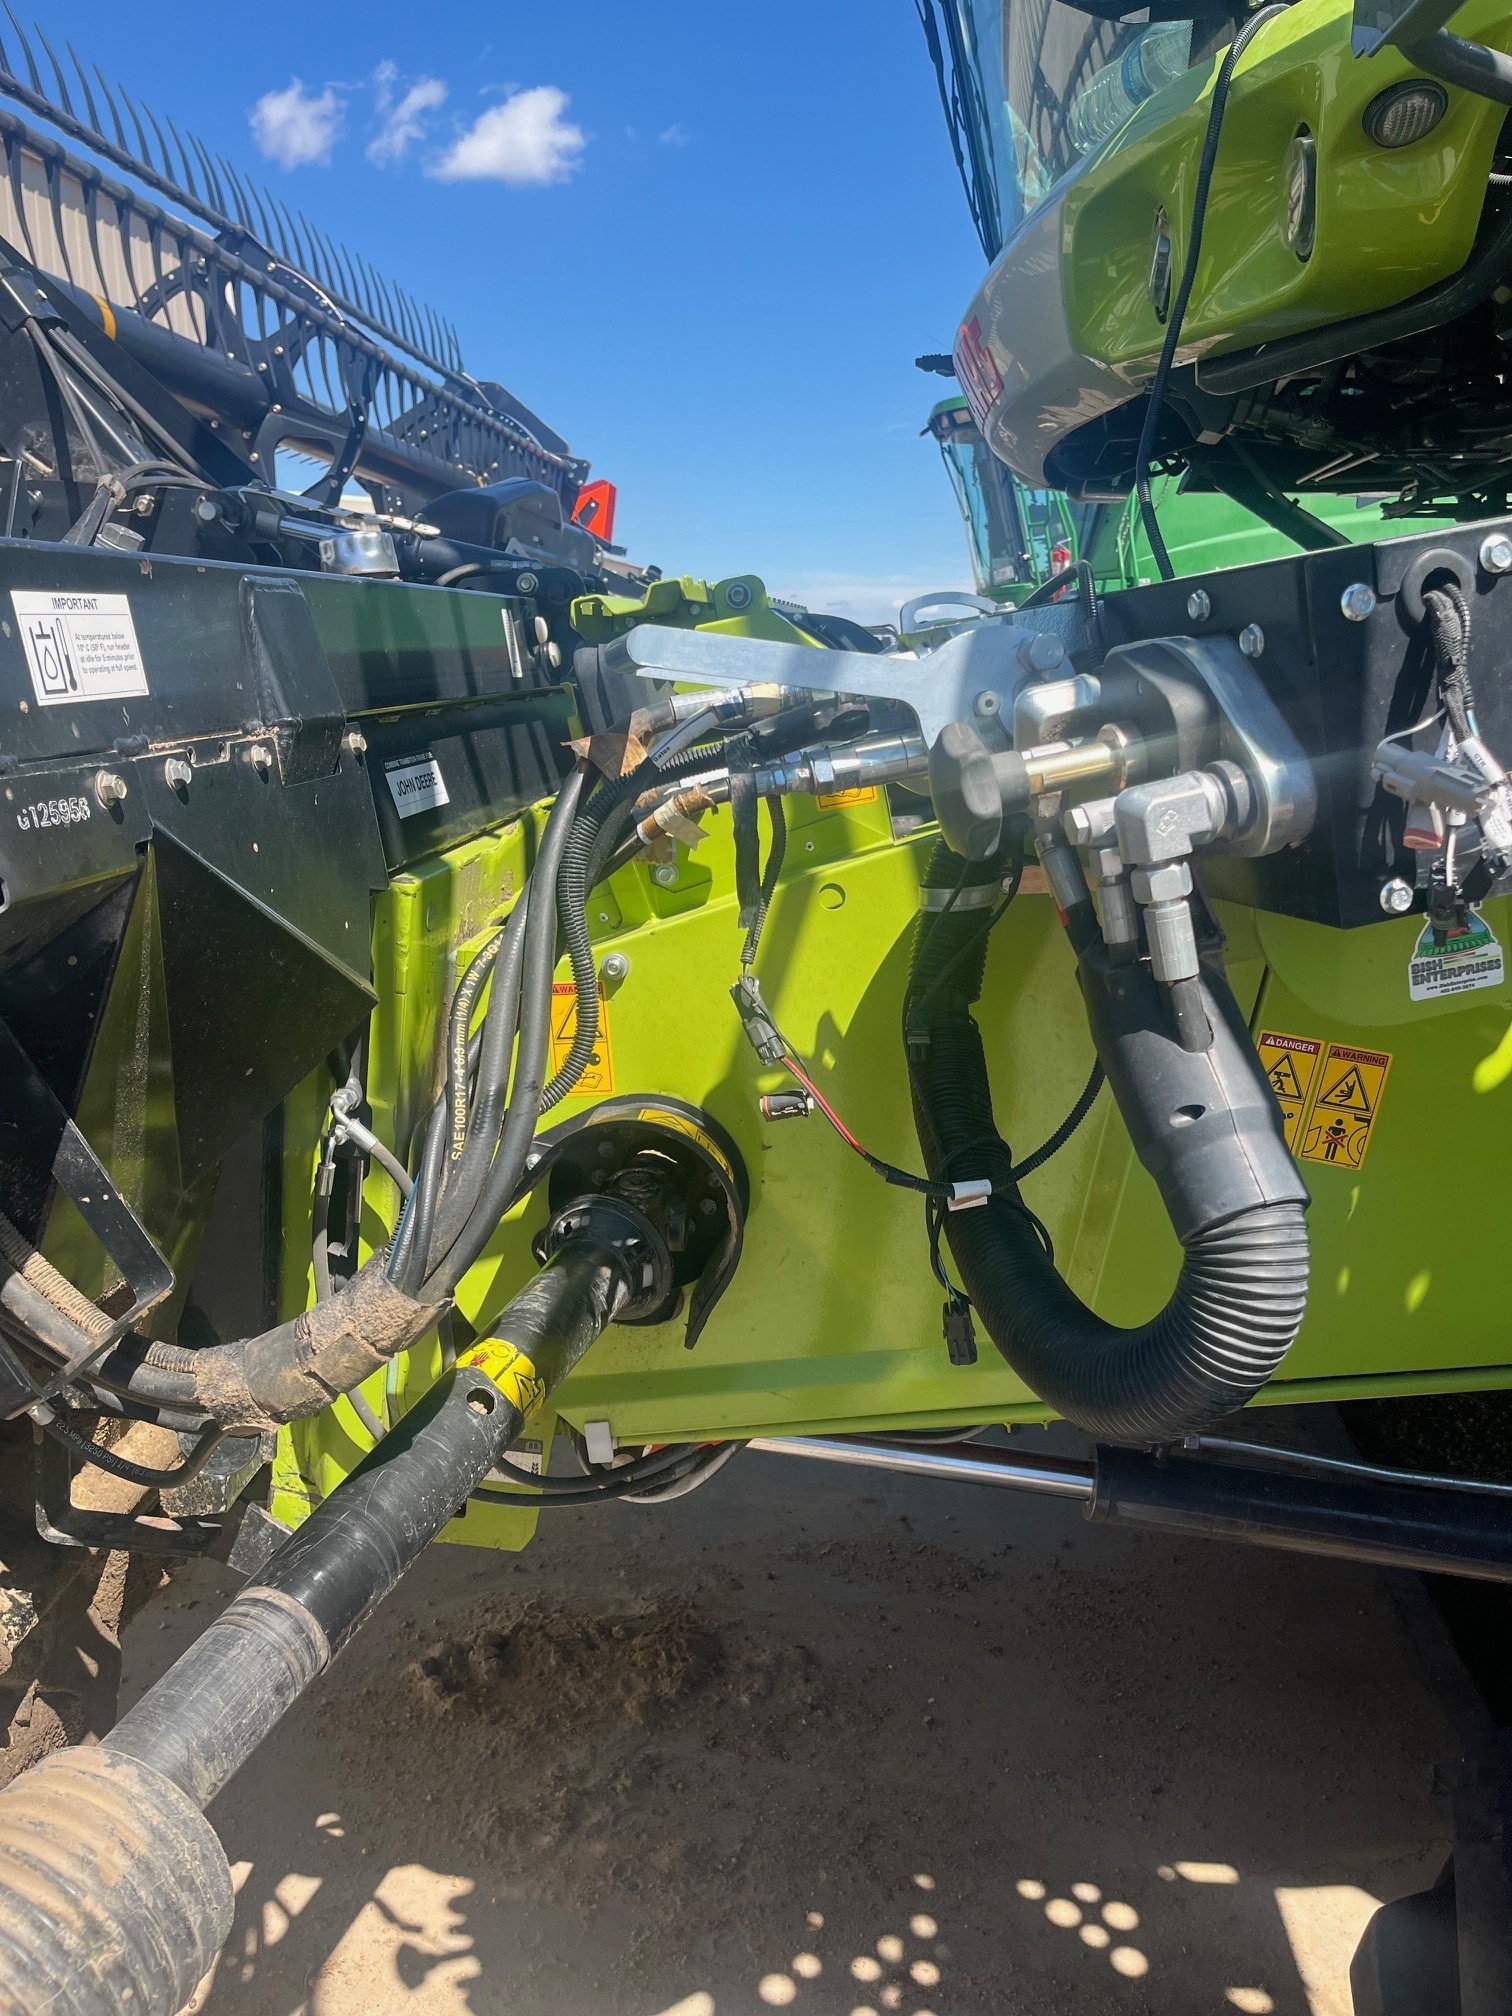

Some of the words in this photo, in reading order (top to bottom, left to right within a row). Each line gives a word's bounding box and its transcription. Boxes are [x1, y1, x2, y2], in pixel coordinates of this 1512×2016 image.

[51, 597, 98, 610] IMPORTANT
[81, 633, 111, 642] temperatures
[111, 632, 125, 640] below
[115, 642, 130, 650] header
[106, 653, 124, 661] minutes
[124, 653, 135, 661] prior
[89, 665, 111, 675] operating
[115, 663, 123, 671] full
[396, 777, 417, 797] JOHN
[415, 771, 438, 790] DEERE
[1411, 959, 1443, 975] BISH
[1412, 958, 1502, 986] ENTERPRISES
[1275, 1038, 1315, 1053] DANGER
[1341, 1050, 1386, 1066] WARNING
[68, 1430, 83, 1445] MPa
